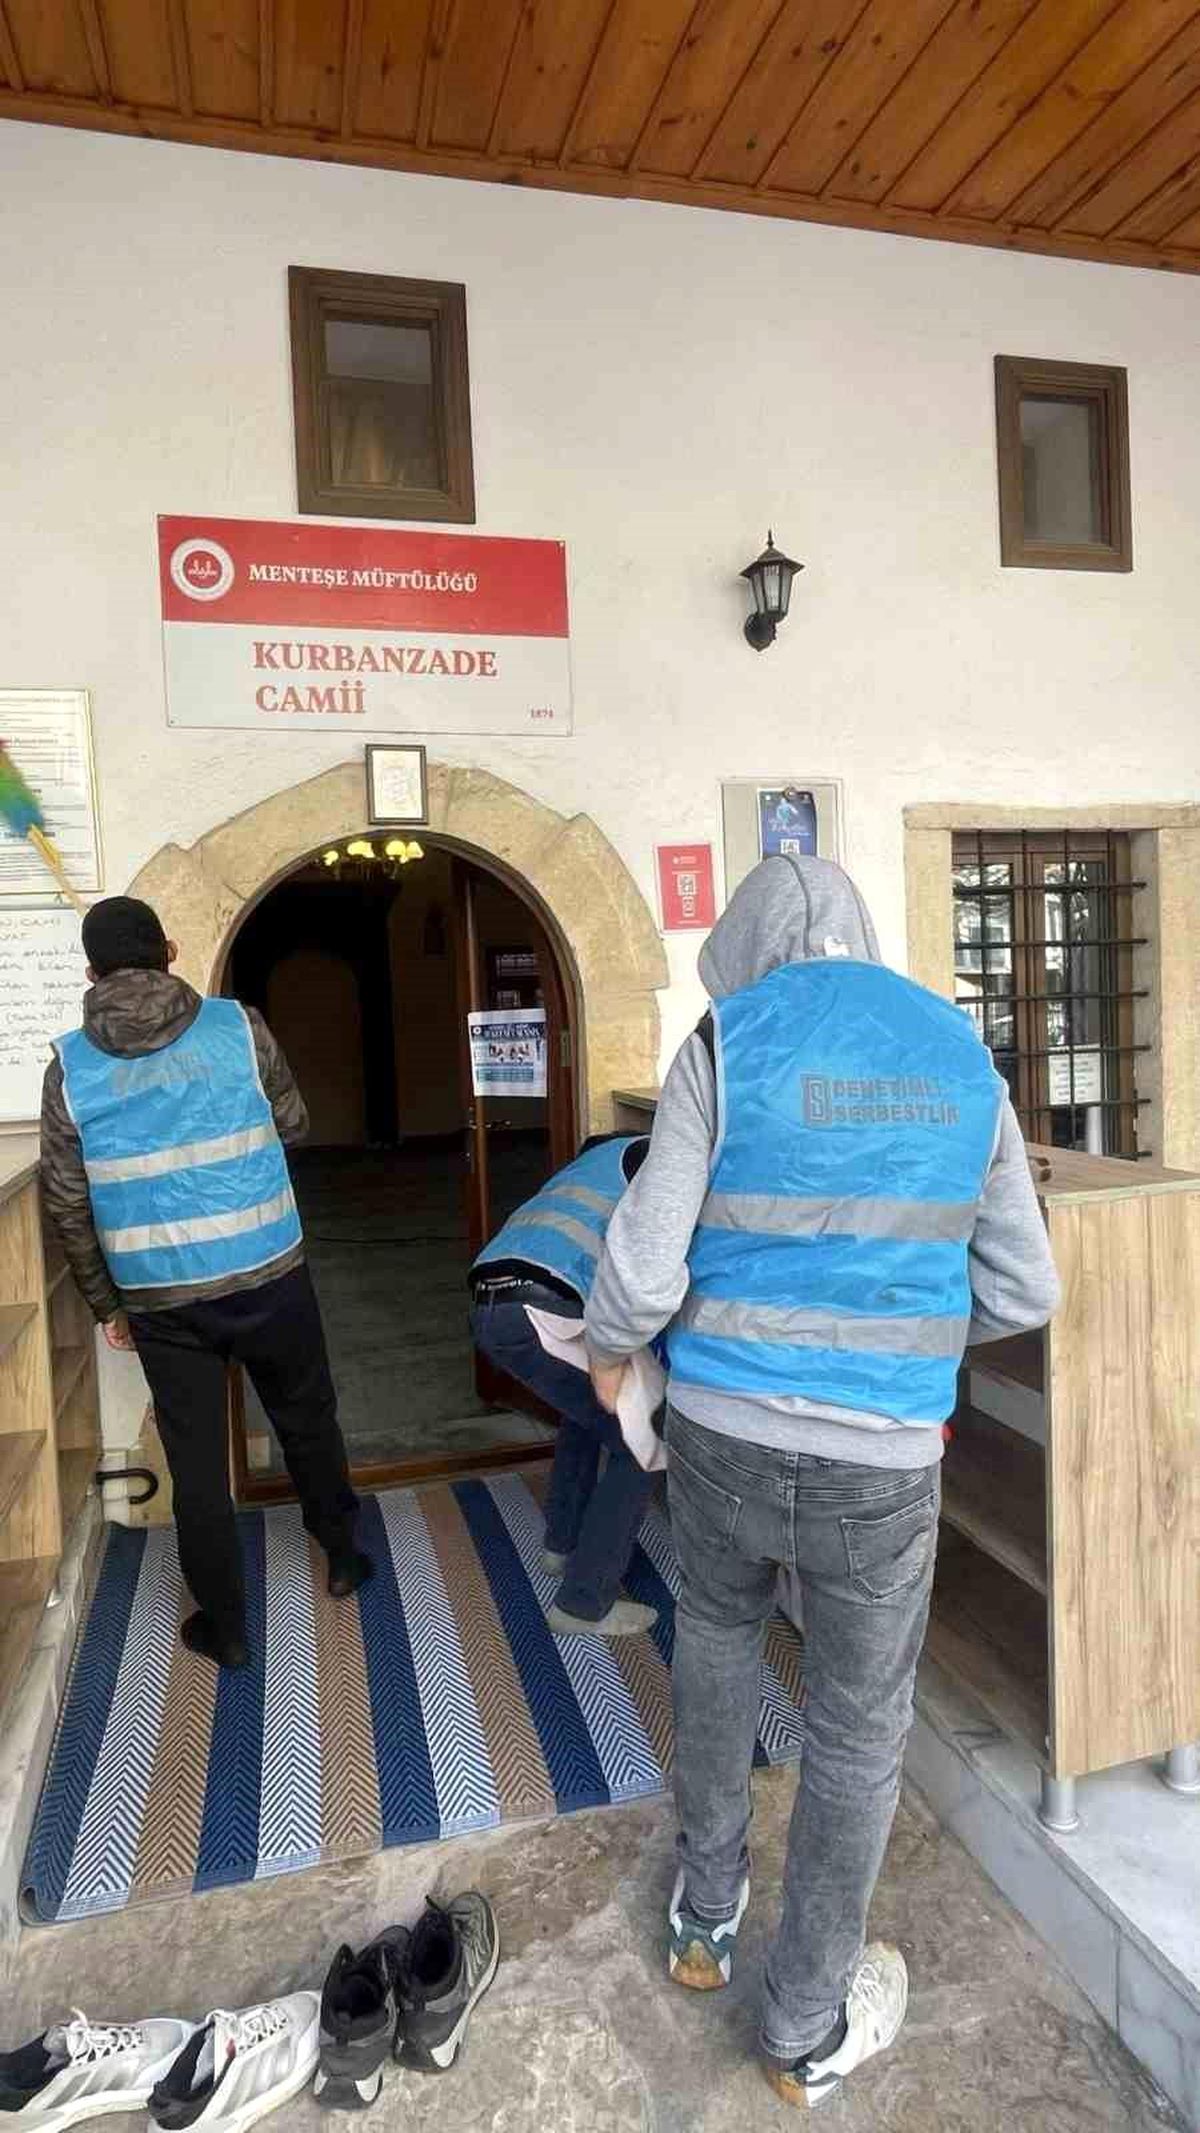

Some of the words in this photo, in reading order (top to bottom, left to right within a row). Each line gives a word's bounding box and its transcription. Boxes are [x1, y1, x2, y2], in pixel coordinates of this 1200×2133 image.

[249, 564, 349, 589] MENTEŞE
[351, 569, 478, 594] MÜFTÜLÜĞÜ
[252, 641, 498, 677] KURBANZADE
[255, 680, 366, 714] CAMİİ
